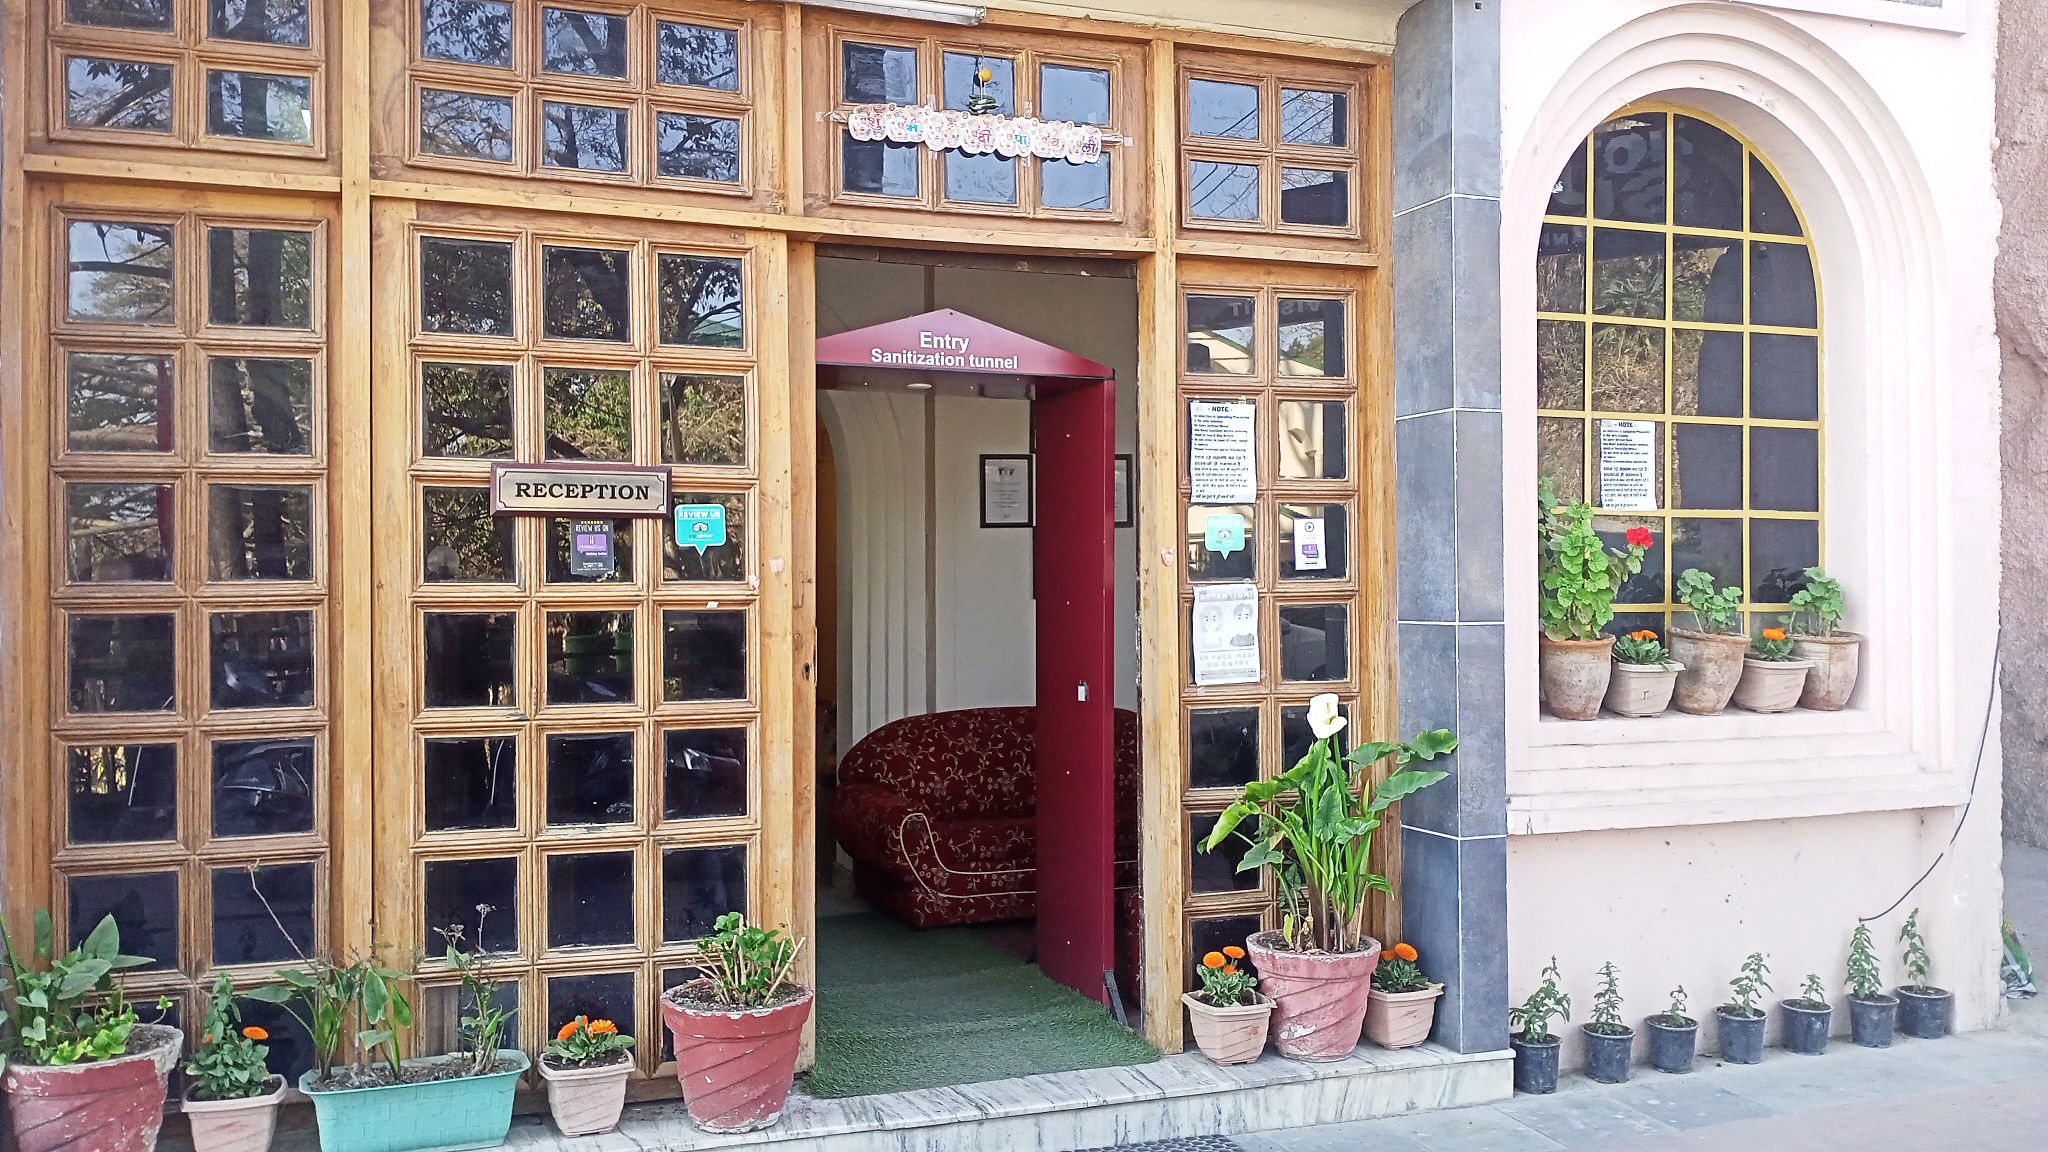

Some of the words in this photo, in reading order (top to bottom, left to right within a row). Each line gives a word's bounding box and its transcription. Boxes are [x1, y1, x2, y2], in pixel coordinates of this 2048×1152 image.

[920, 331, 970, 353] Entry
[871, 348, 965, 367] Sanitization
[969, 354, 1018, 369] tunnel
[515, 482, 650, 500] RECEPTION
